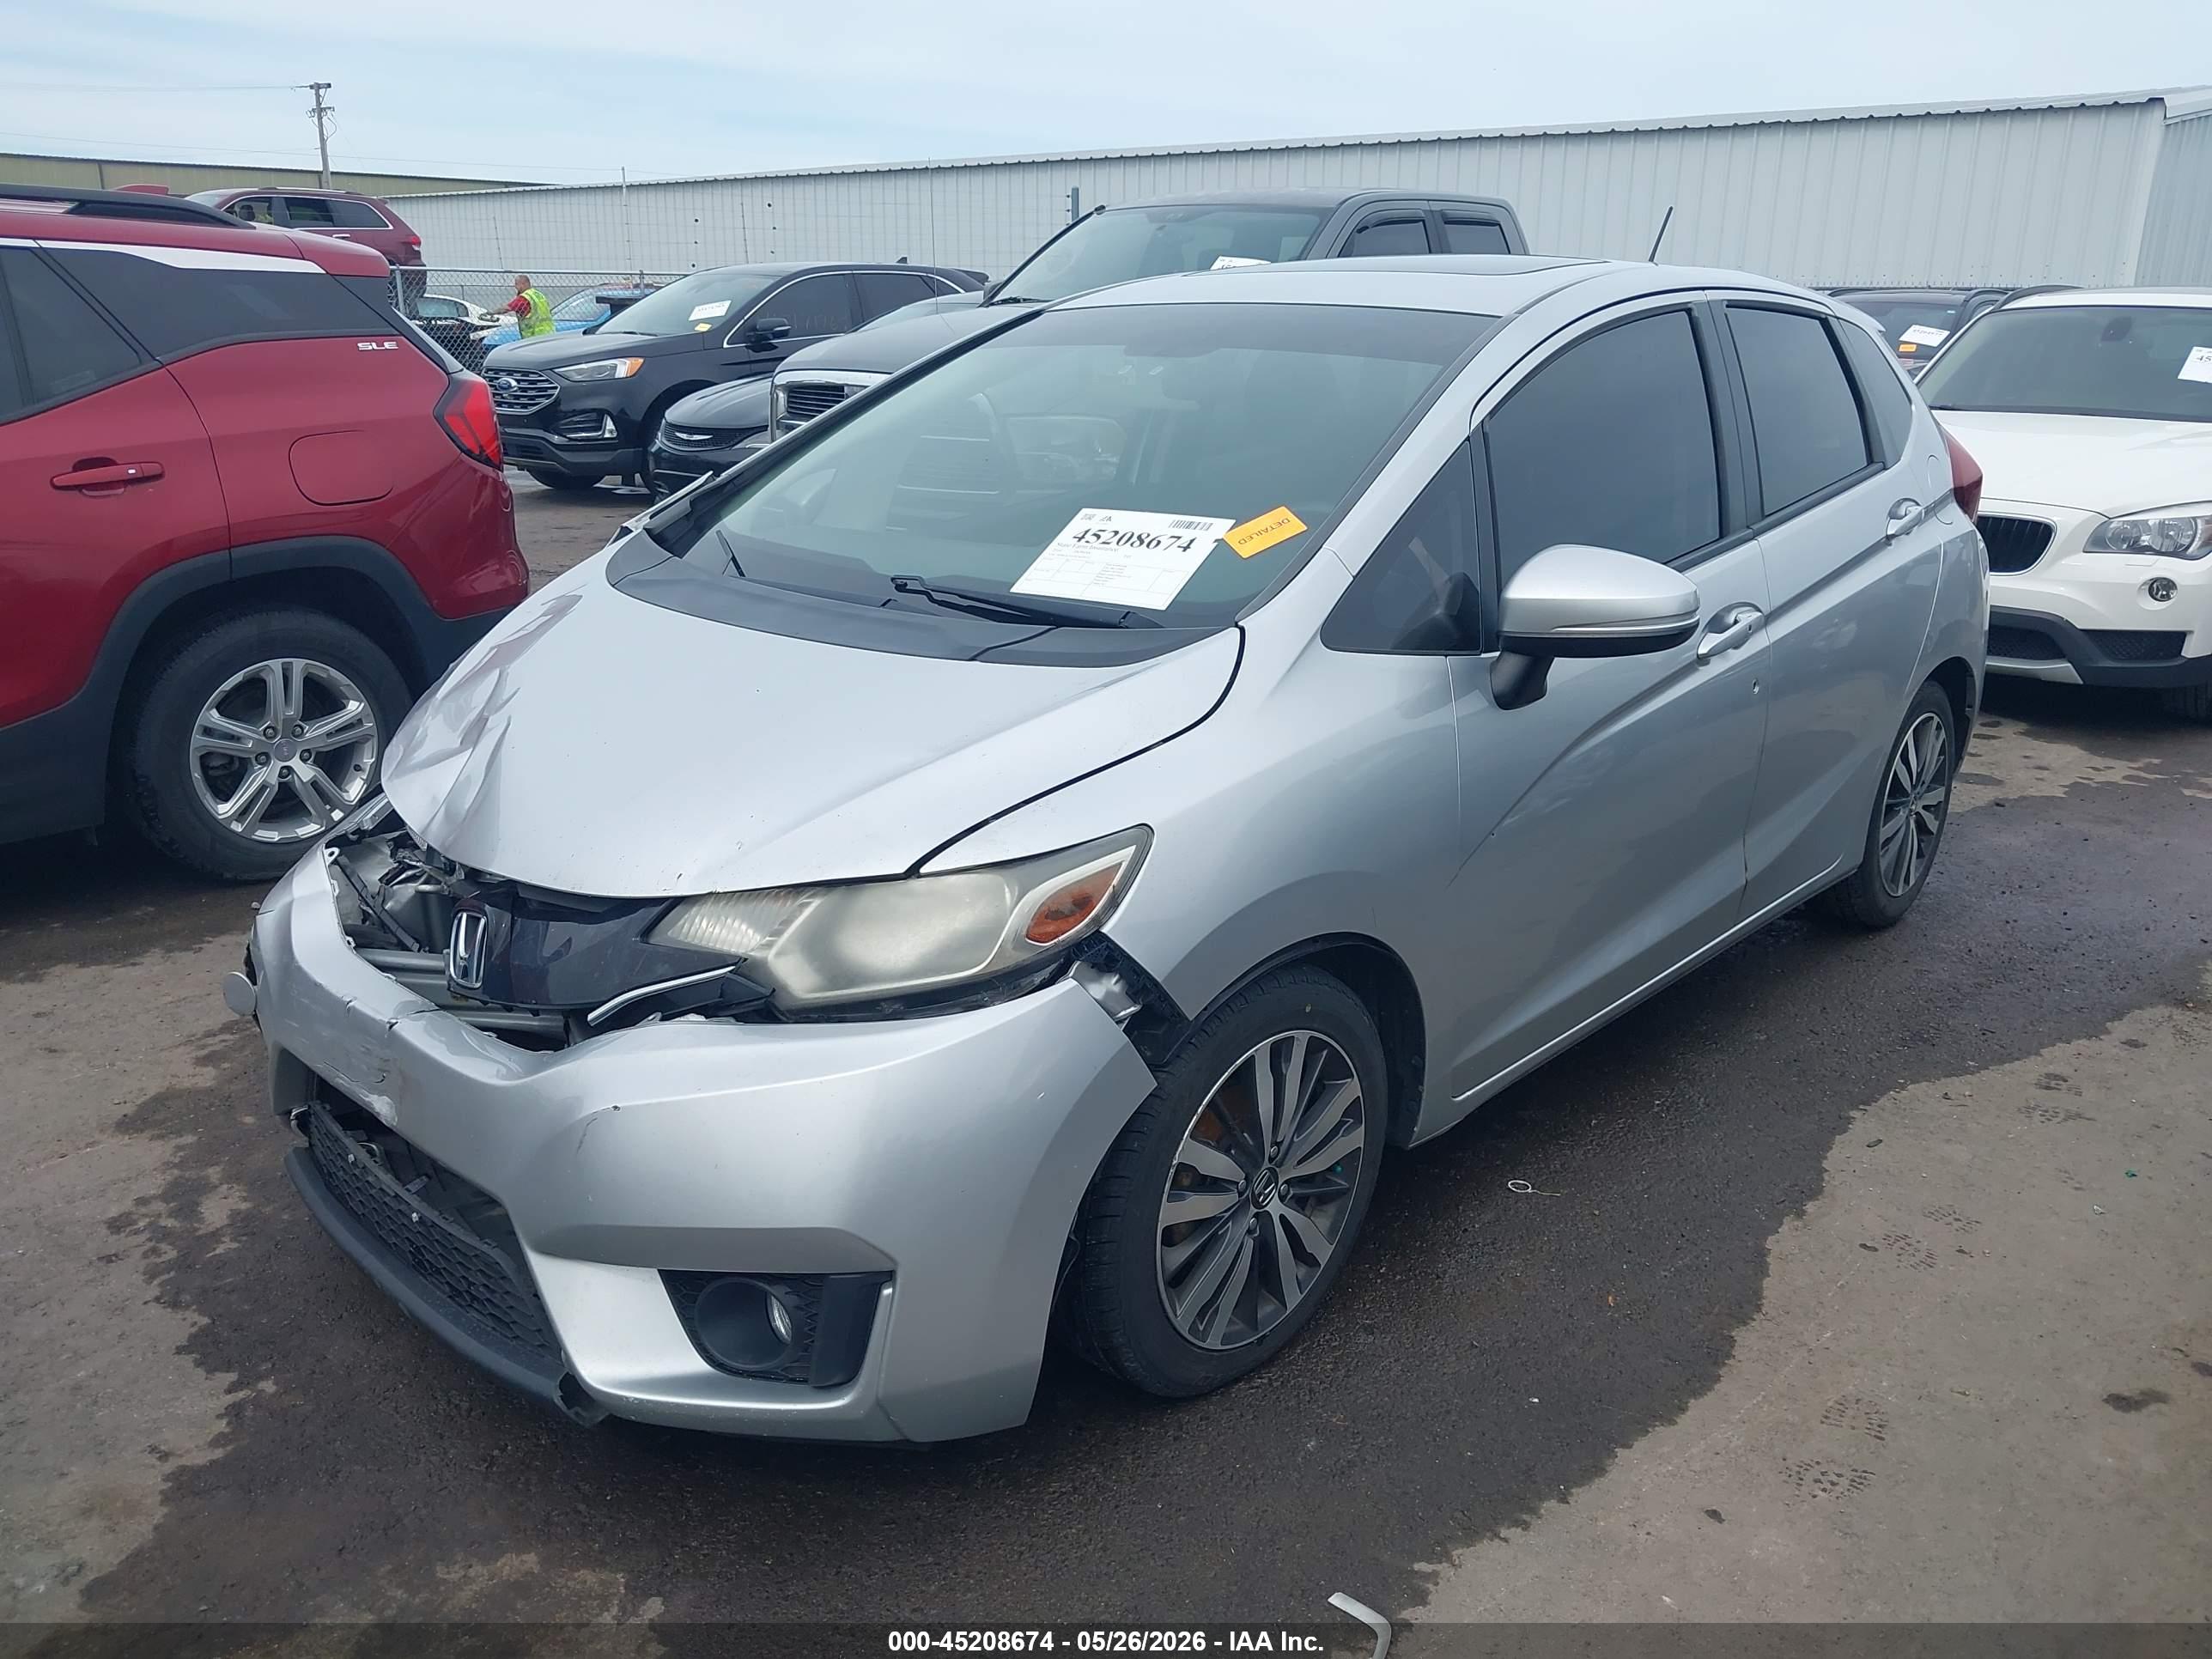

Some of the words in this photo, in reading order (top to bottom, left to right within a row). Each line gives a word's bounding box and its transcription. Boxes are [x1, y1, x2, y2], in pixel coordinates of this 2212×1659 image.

[357, 342, 398, 350] SLE
[1073, 528, 1198, 552] 45208674
[1238, 518, 1291, 544] DETAILED
